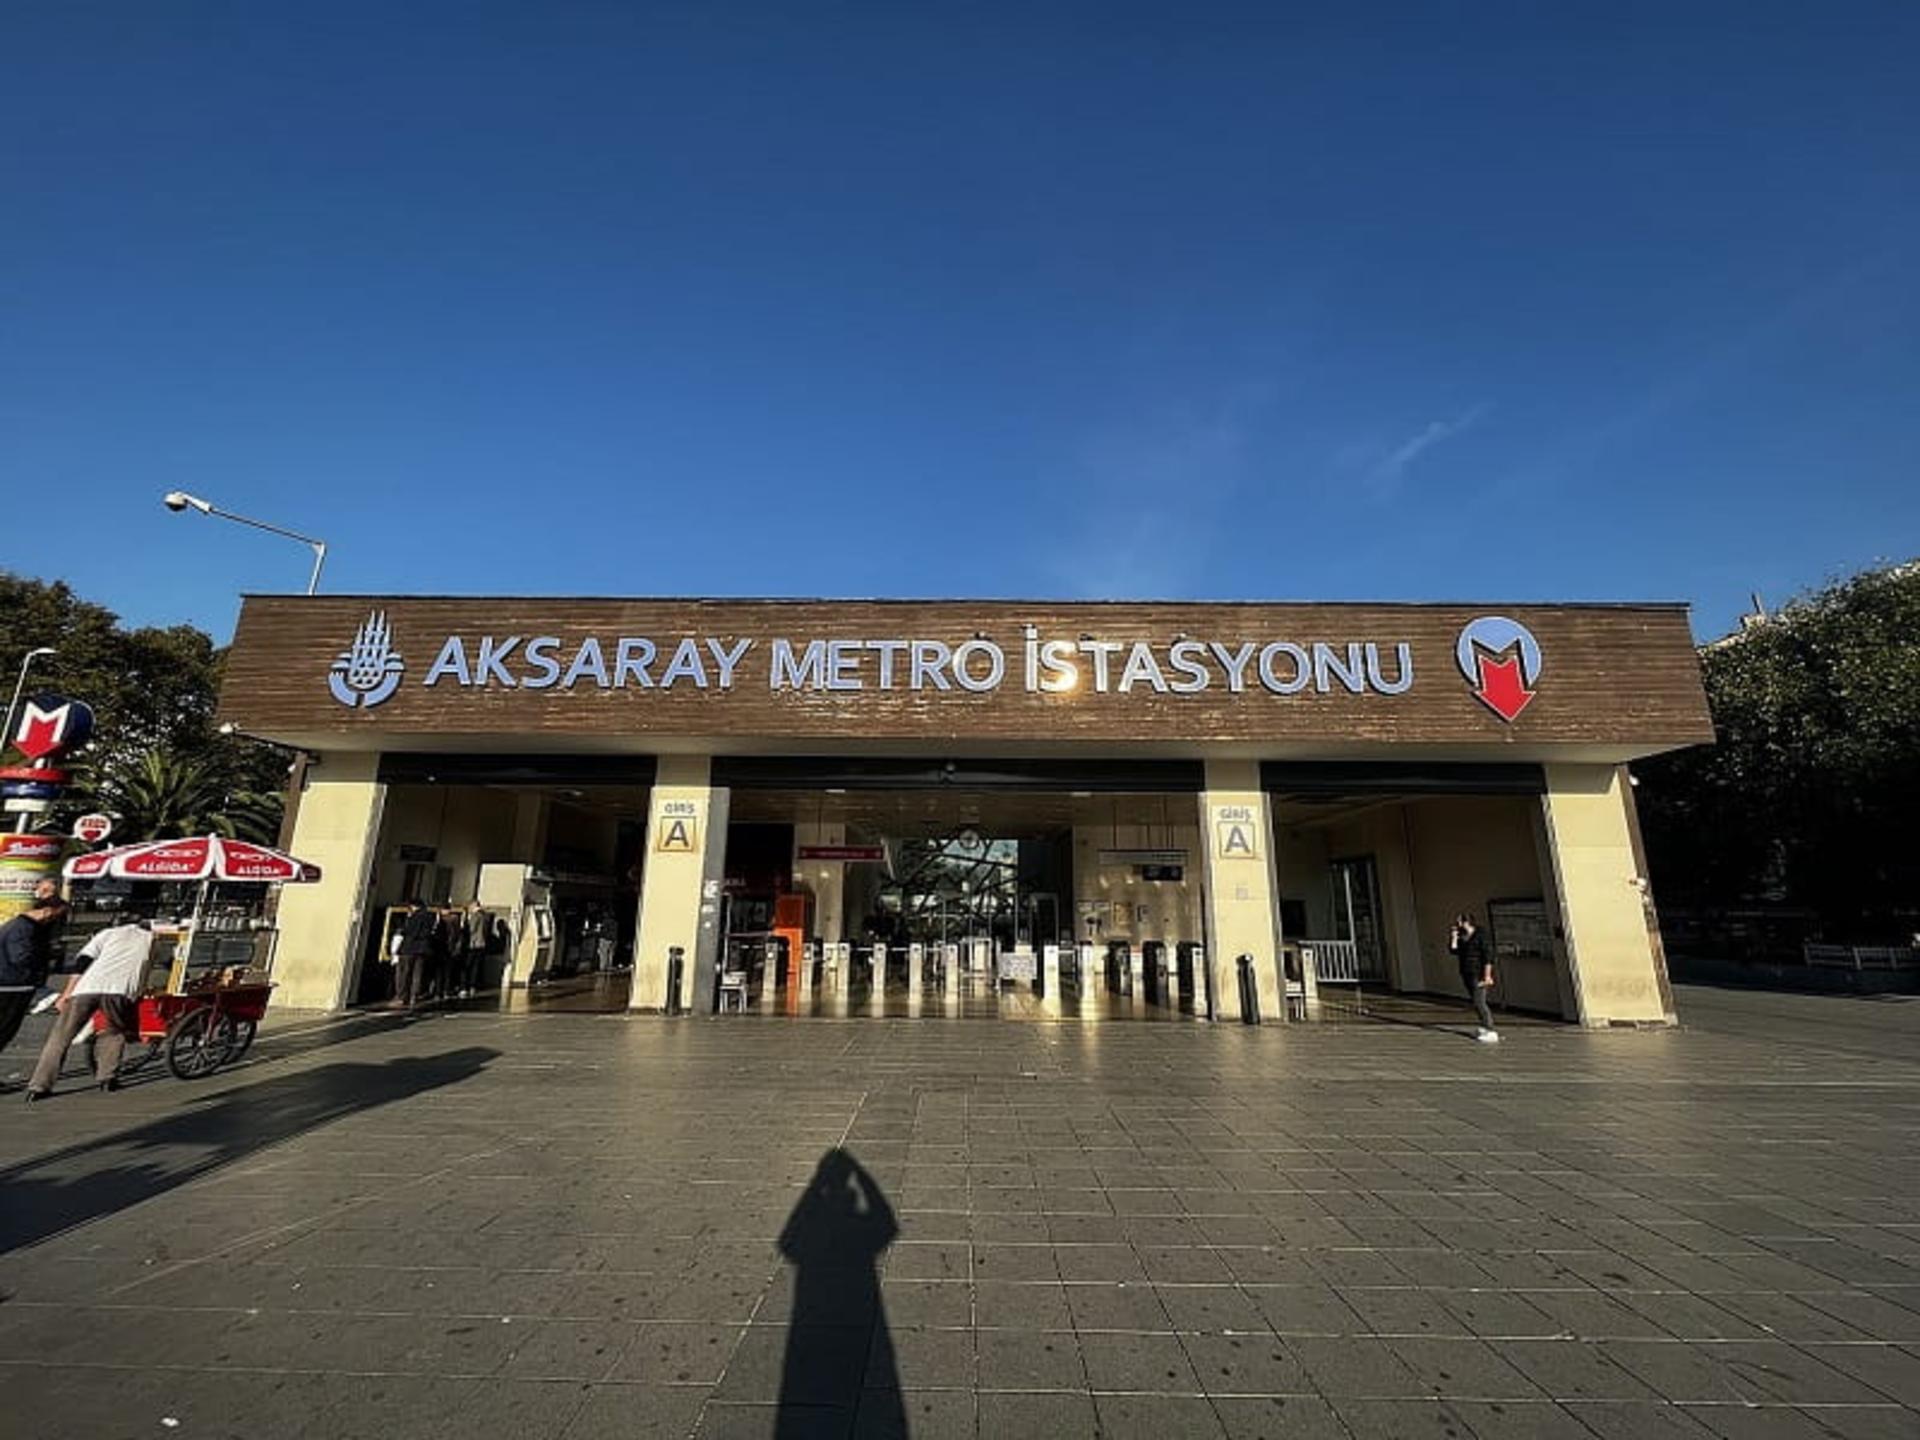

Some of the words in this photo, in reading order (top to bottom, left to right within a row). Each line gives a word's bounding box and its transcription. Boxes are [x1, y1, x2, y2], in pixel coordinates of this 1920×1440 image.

[423, 635, 752, 689] AKSARAY
[770, 637, 1005, 693] METRO
[1025, 626, 1413, 695] İSTASYONU
[664, 820, 690, 848] A
[1225, 825, 1251, 853] A
